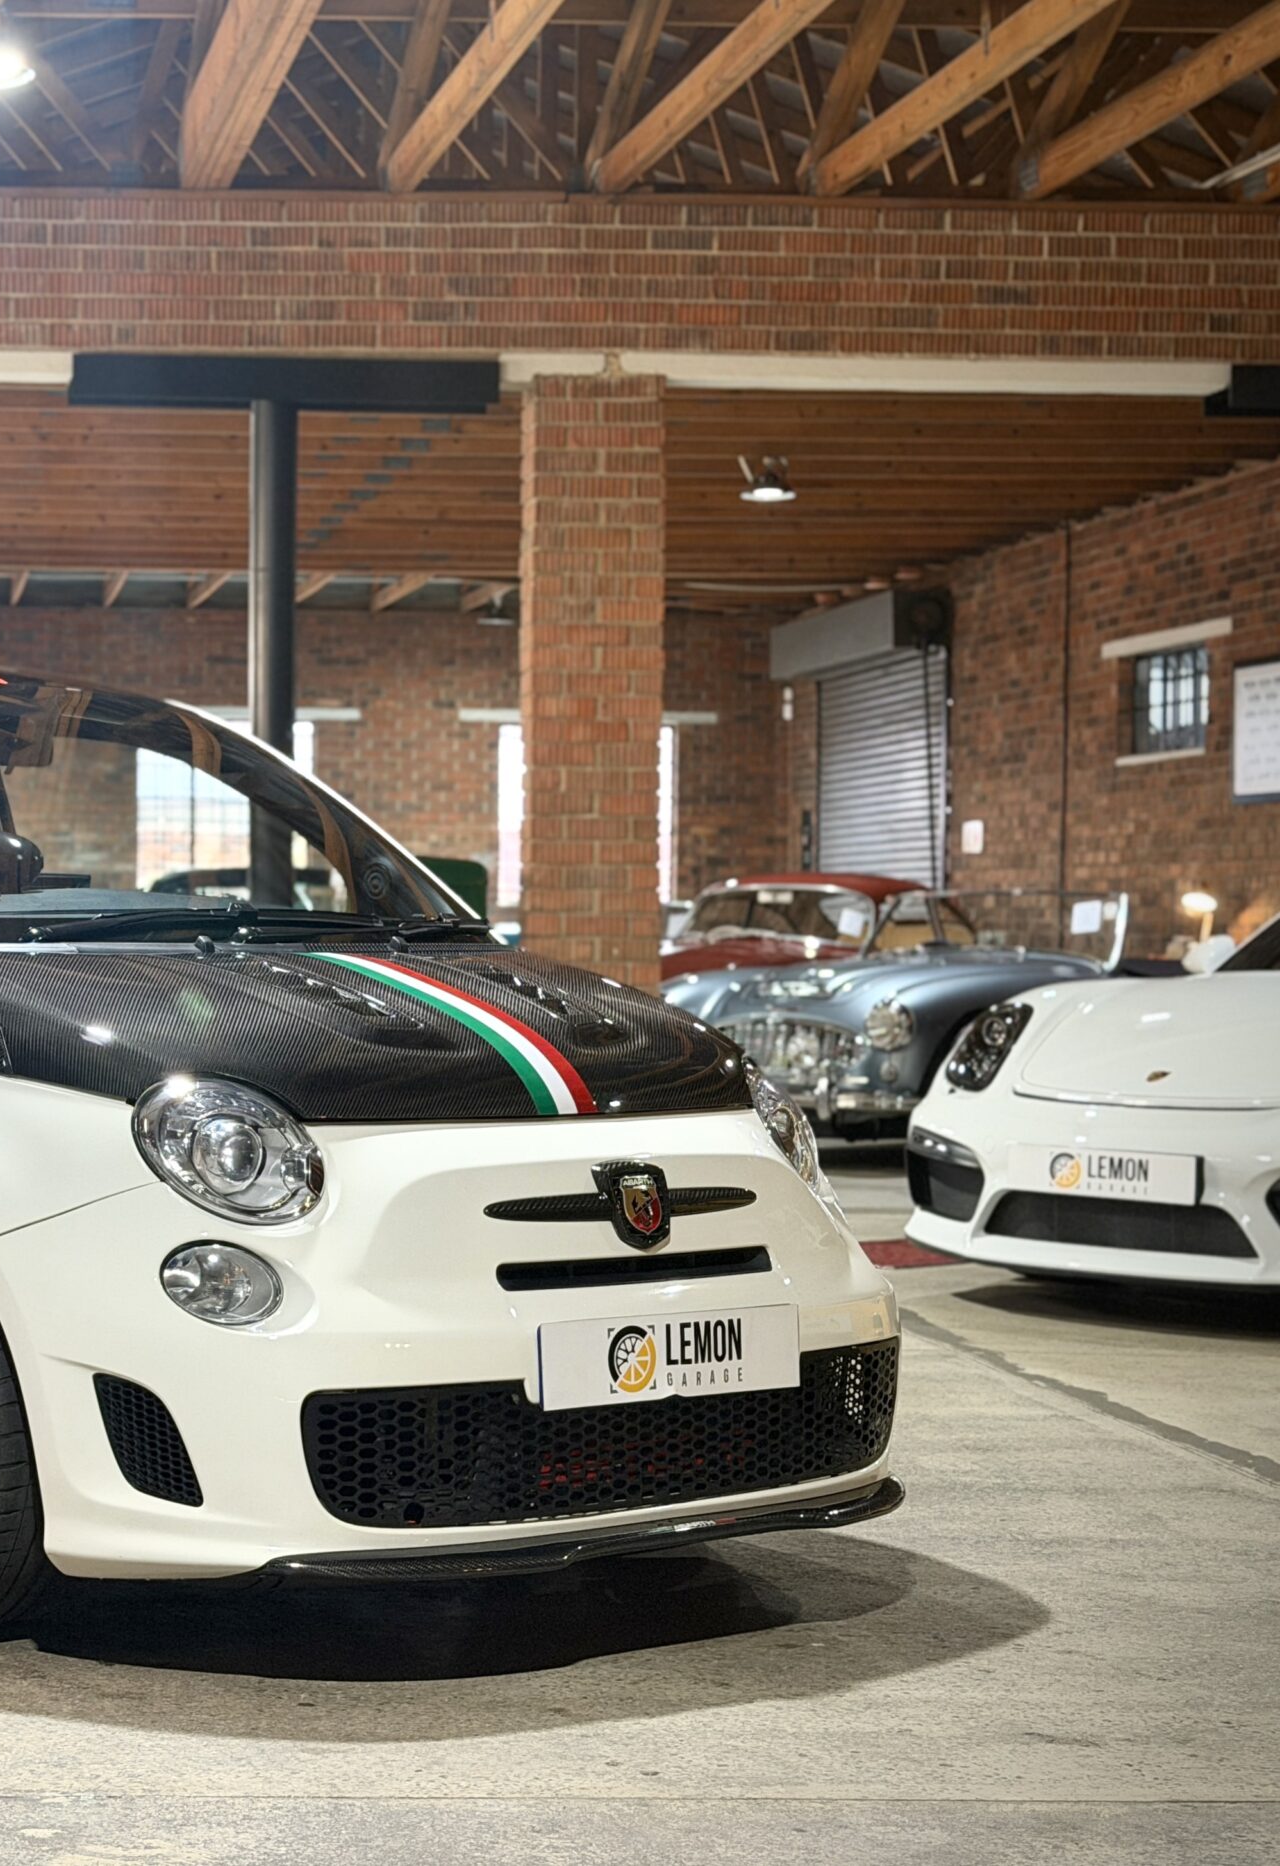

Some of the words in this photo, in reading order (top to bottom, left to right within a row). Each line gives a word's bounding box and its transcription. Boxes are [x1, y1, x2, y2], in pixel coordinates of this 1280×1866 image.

[1087, 1154, 1149, 1182] LEMON
[665, 1318, 743, 1366] LEMON
[666, 1367, 744, 1387] GARAGE
